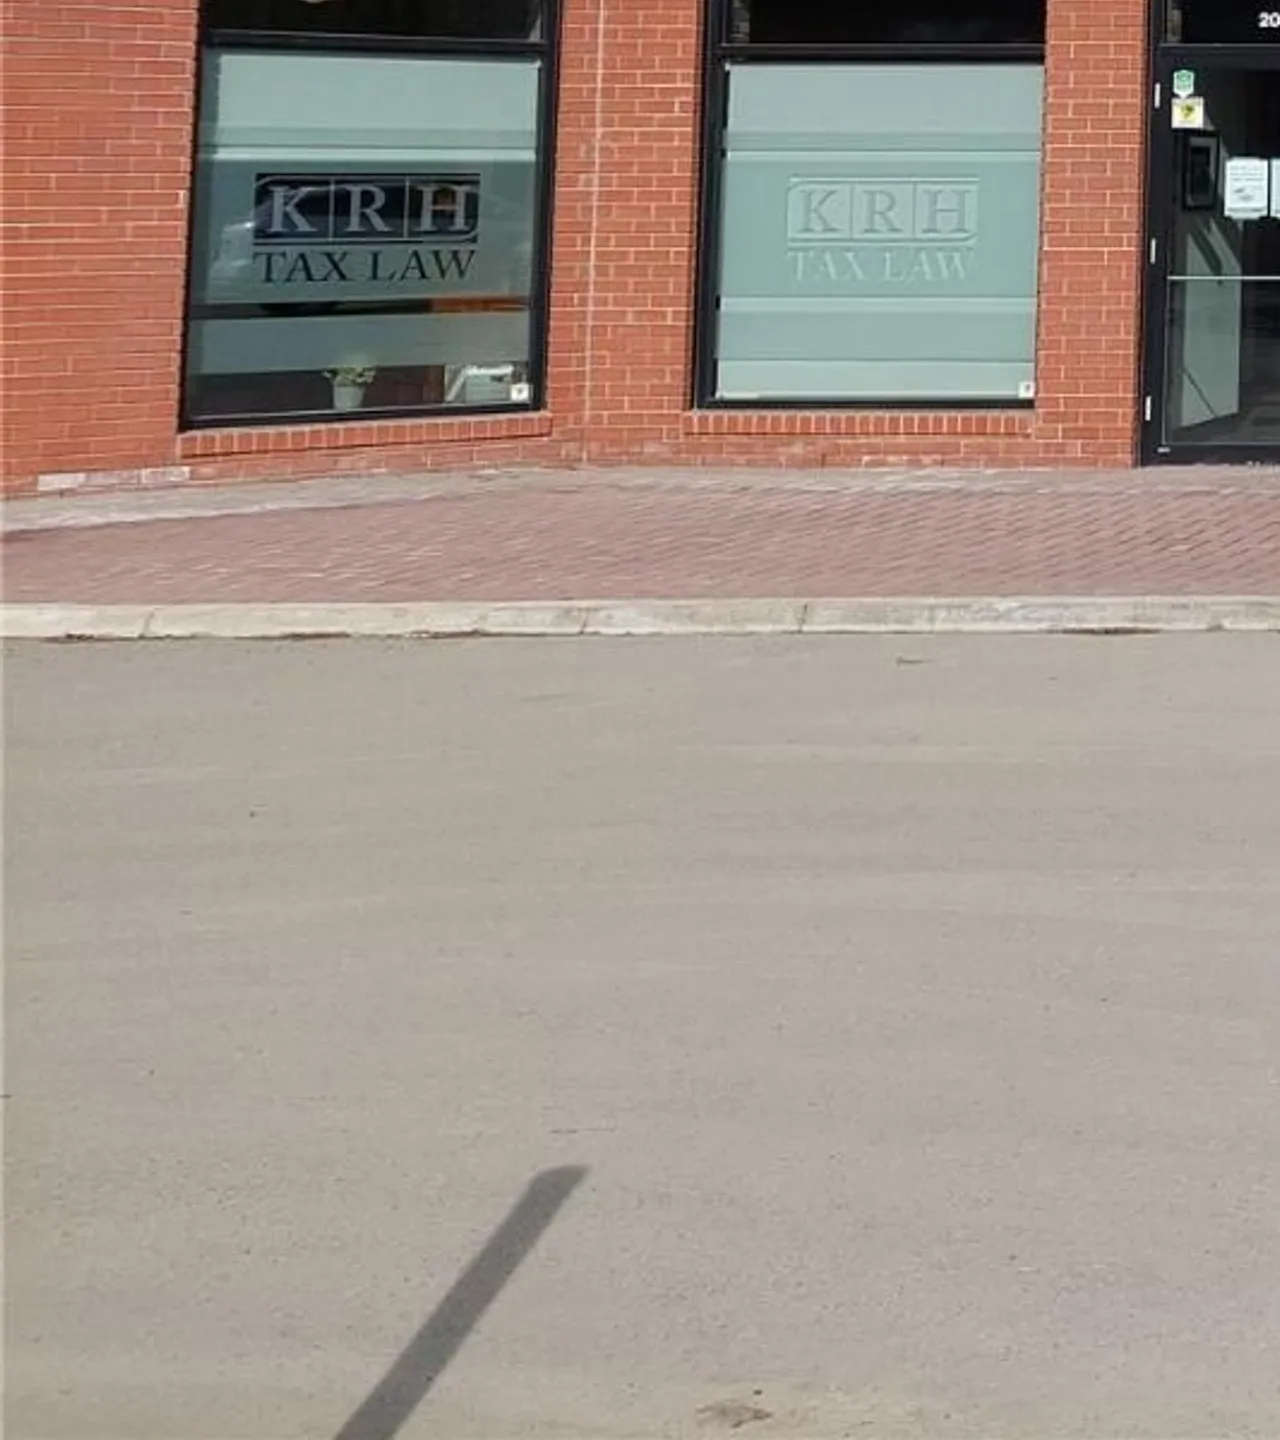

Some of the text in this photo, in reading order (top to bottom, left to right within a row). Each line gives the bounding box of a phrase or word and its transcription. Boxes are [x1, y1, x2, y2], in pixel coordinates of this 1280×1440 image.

[253, 249, 476, 283] TAX LAW
[787, 248, 972, 282] TAX LAW
